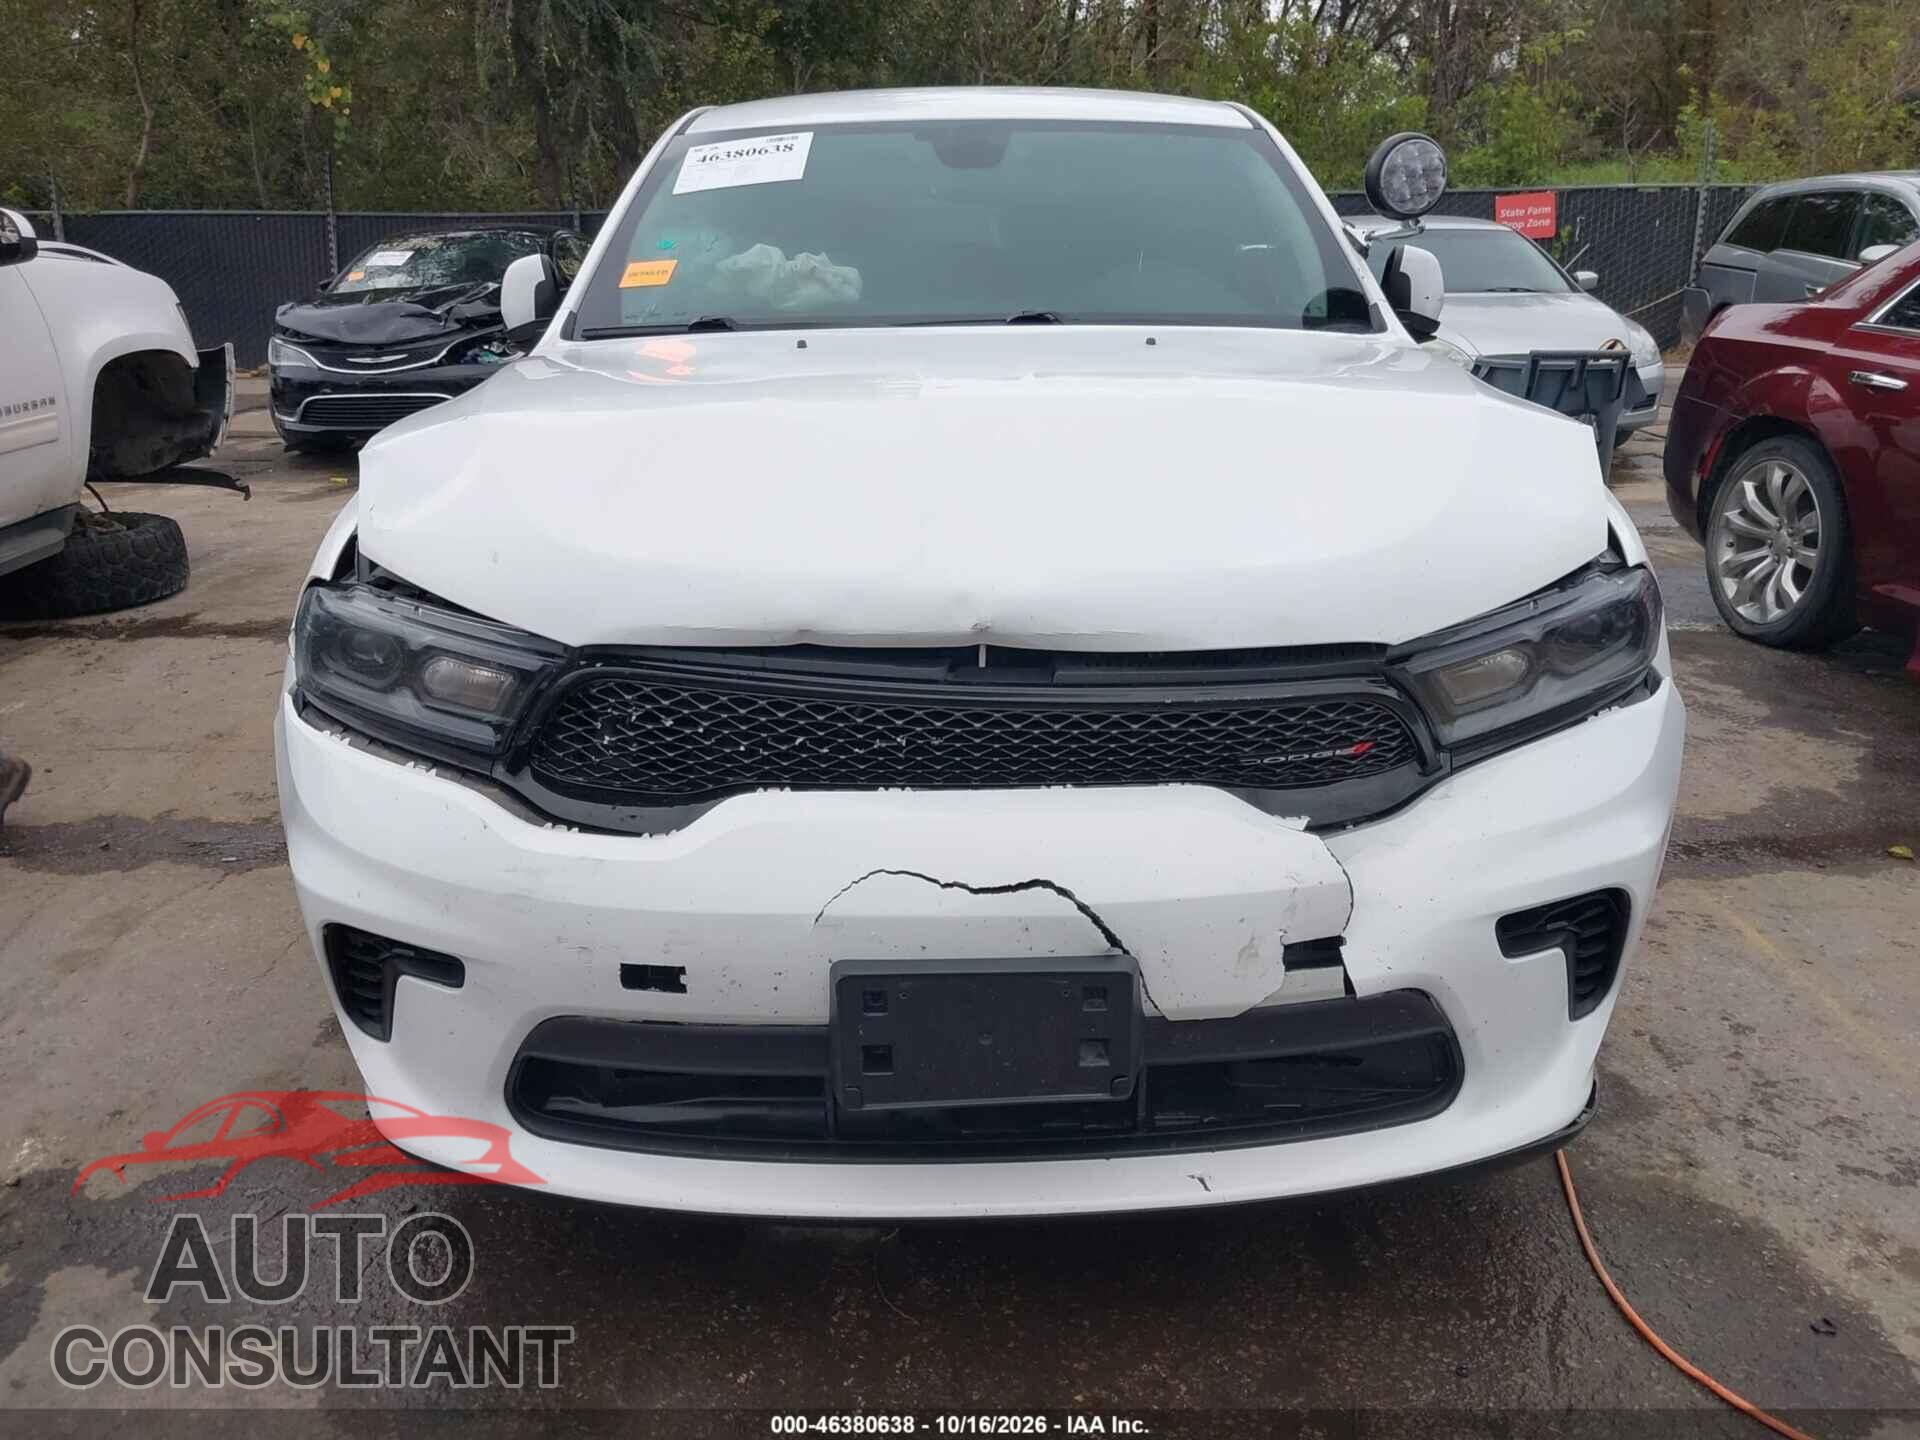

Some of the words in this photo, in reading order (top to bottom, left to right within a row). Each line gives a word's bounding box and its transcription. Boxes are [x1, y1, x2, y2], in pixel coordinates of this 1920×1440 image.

[695, 143, 796, 164] 46380638
[1500, 207, 1525, 218] State
[1527, 206, 1552, 216] Farm
[1527, 218, 1551, 228] Zone
